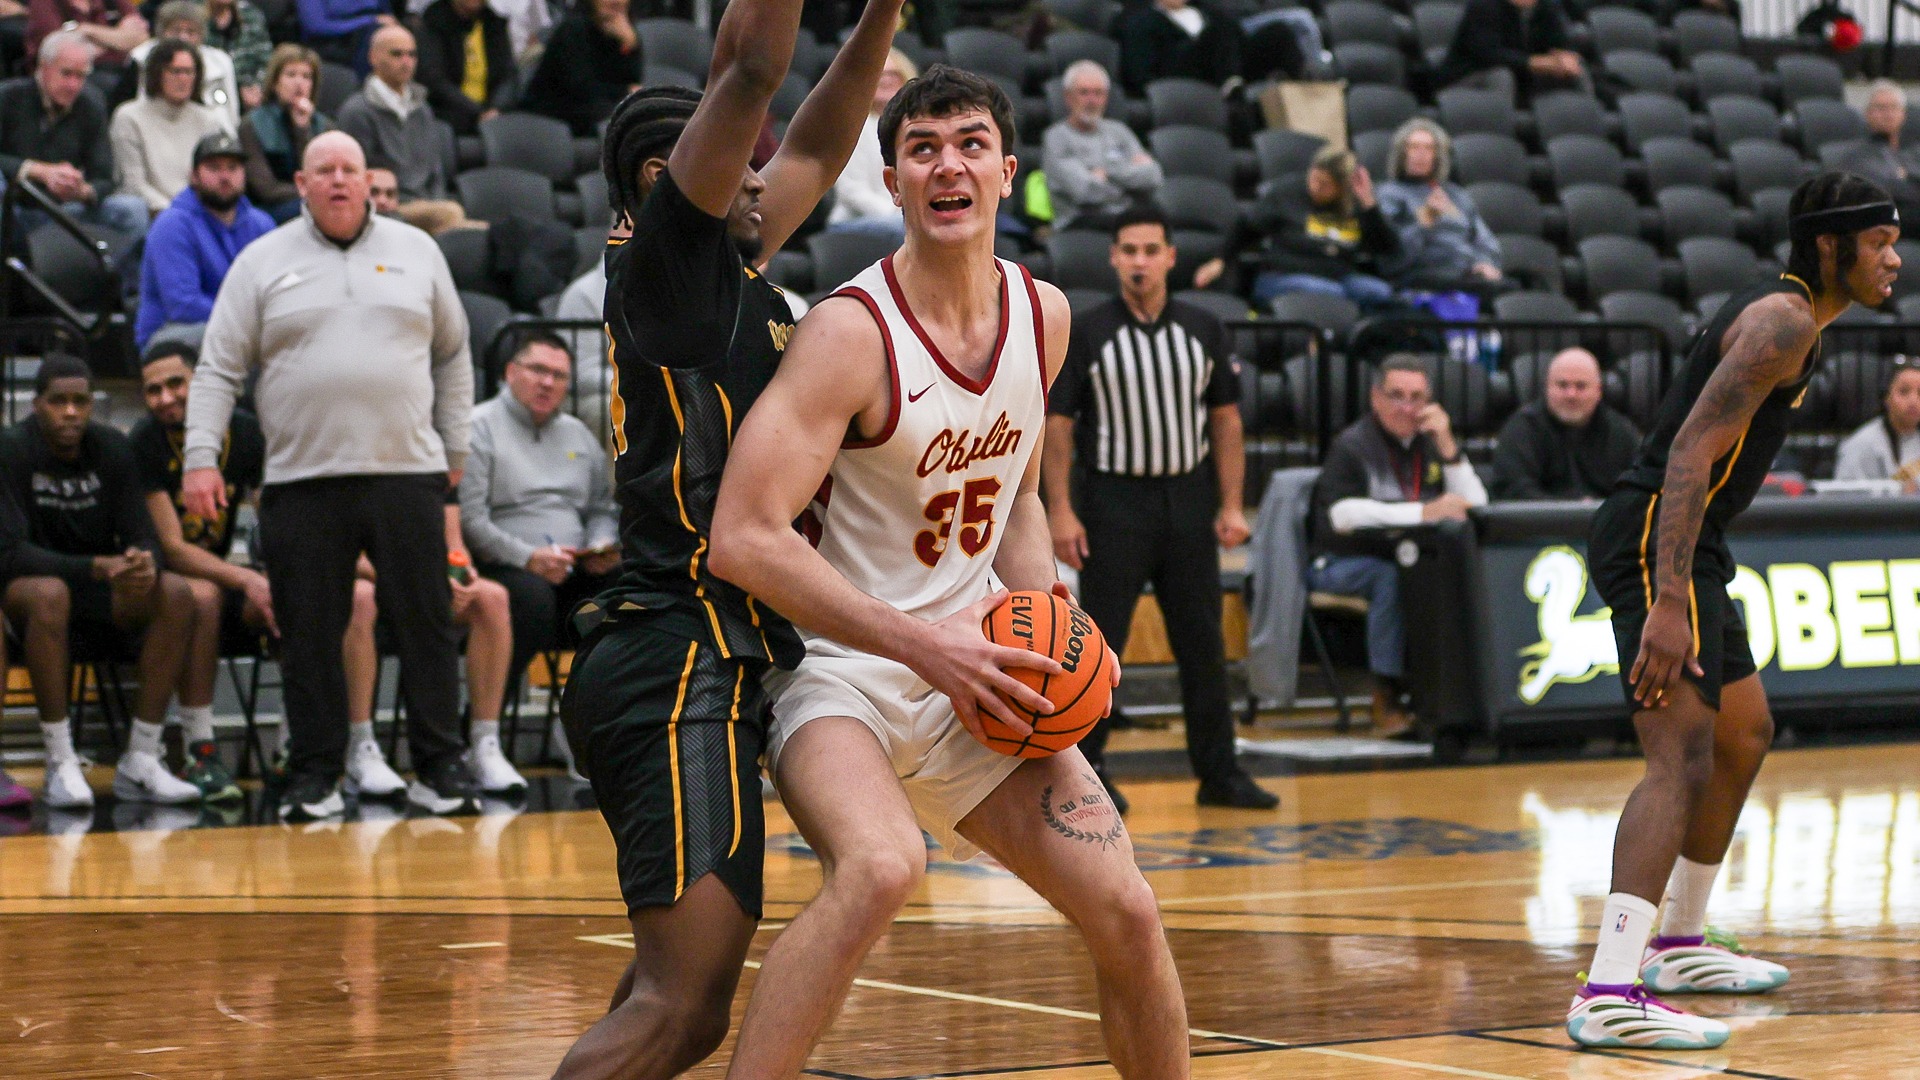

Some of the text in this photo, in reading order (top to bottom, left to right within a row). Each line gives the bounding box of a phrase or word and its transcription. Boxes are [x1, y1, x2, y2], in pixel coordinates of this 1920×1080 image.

[916, 410, 1023, 478] Obrlin
[912, 475, 1003, 569] 35
[1011, 595, 1034, 640] EVO
